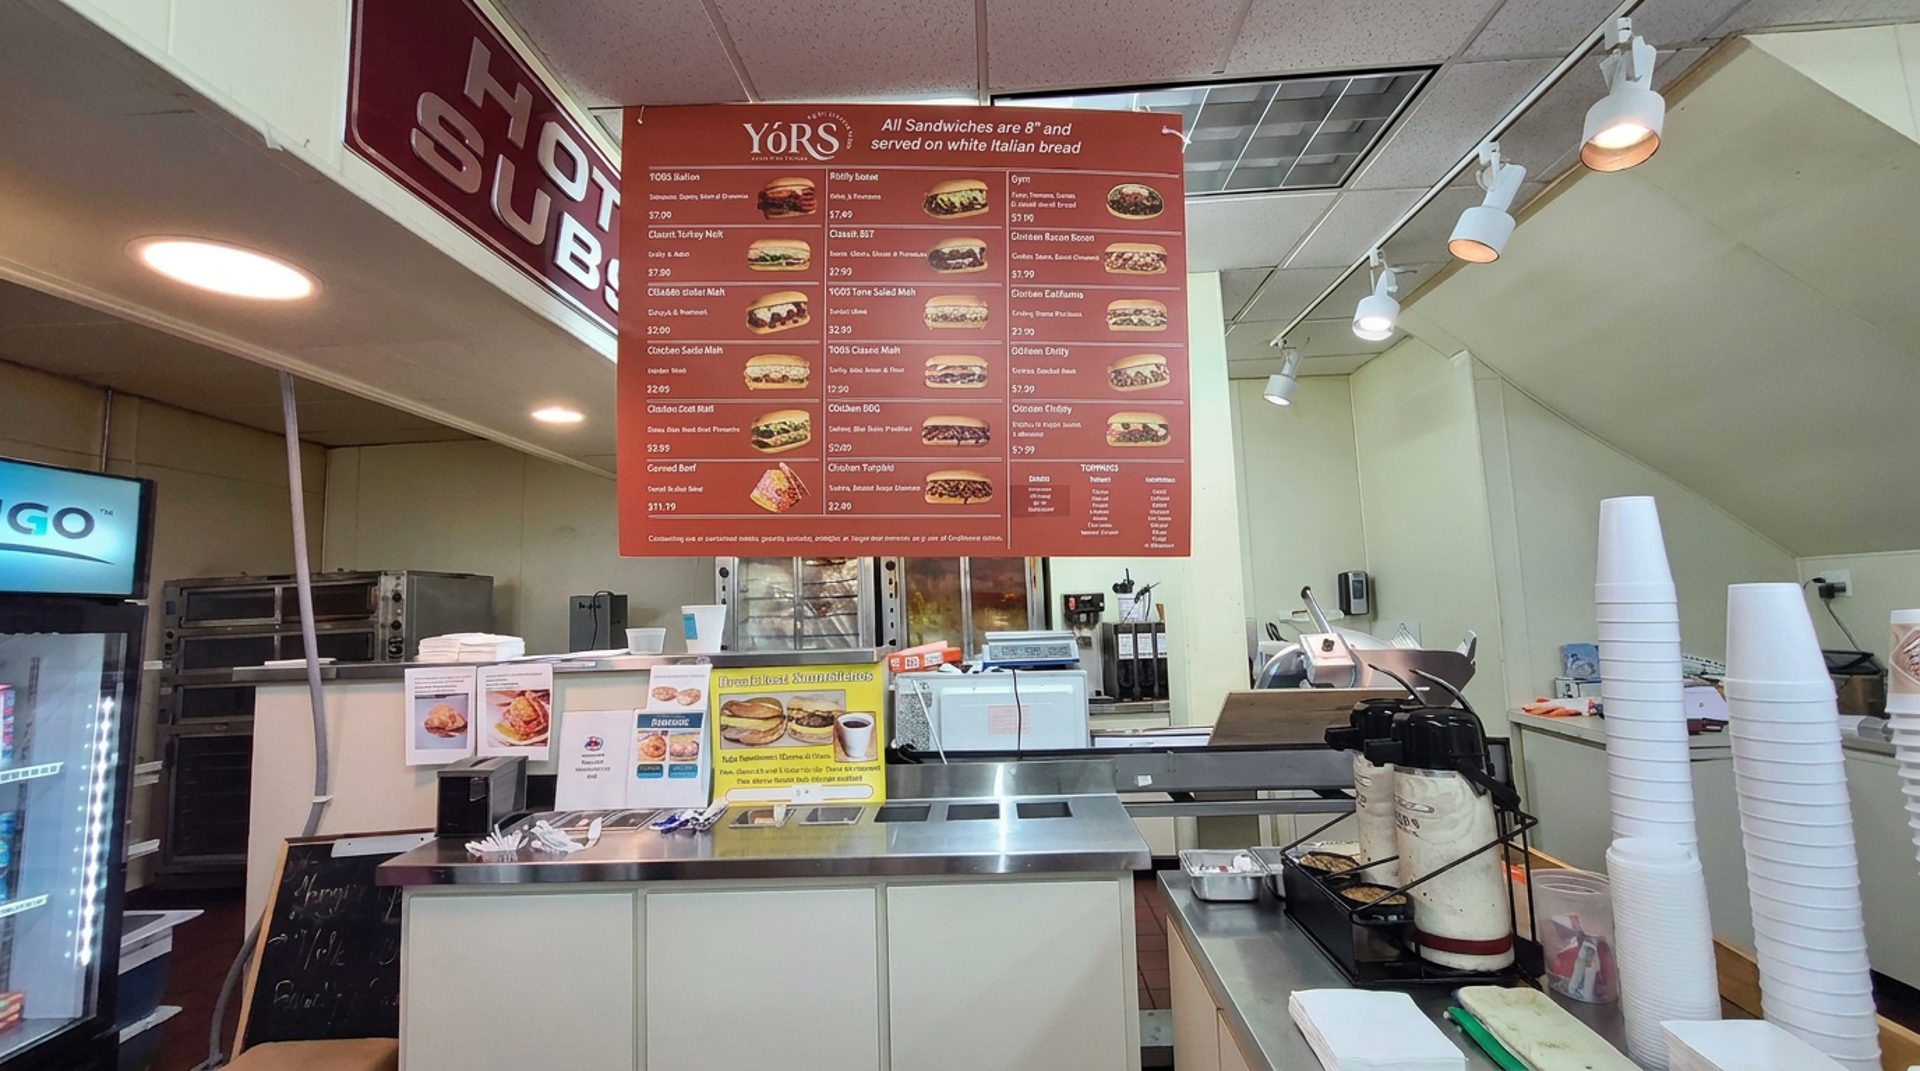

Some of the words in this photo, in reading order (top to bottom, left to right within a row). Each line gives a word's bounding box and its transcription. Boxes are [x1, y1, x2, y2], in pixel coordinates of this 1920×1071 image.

[463, 36, 621, 233] HOT
[881, 118, 902, 132] All
[905, 119, 993, 134] Sandwiches
[997, 123, 1021, 134] are
[1024, 121, 1042, 134] 8"
[1044, 123, 1072, 136] and
[871, 137, 922, 150] served
[924, 140, 943, 151] on
[947, 139, 987, 152] white
[991, 139, 1035, 153] Italian
[1039, 141, 1081, 155] bread
